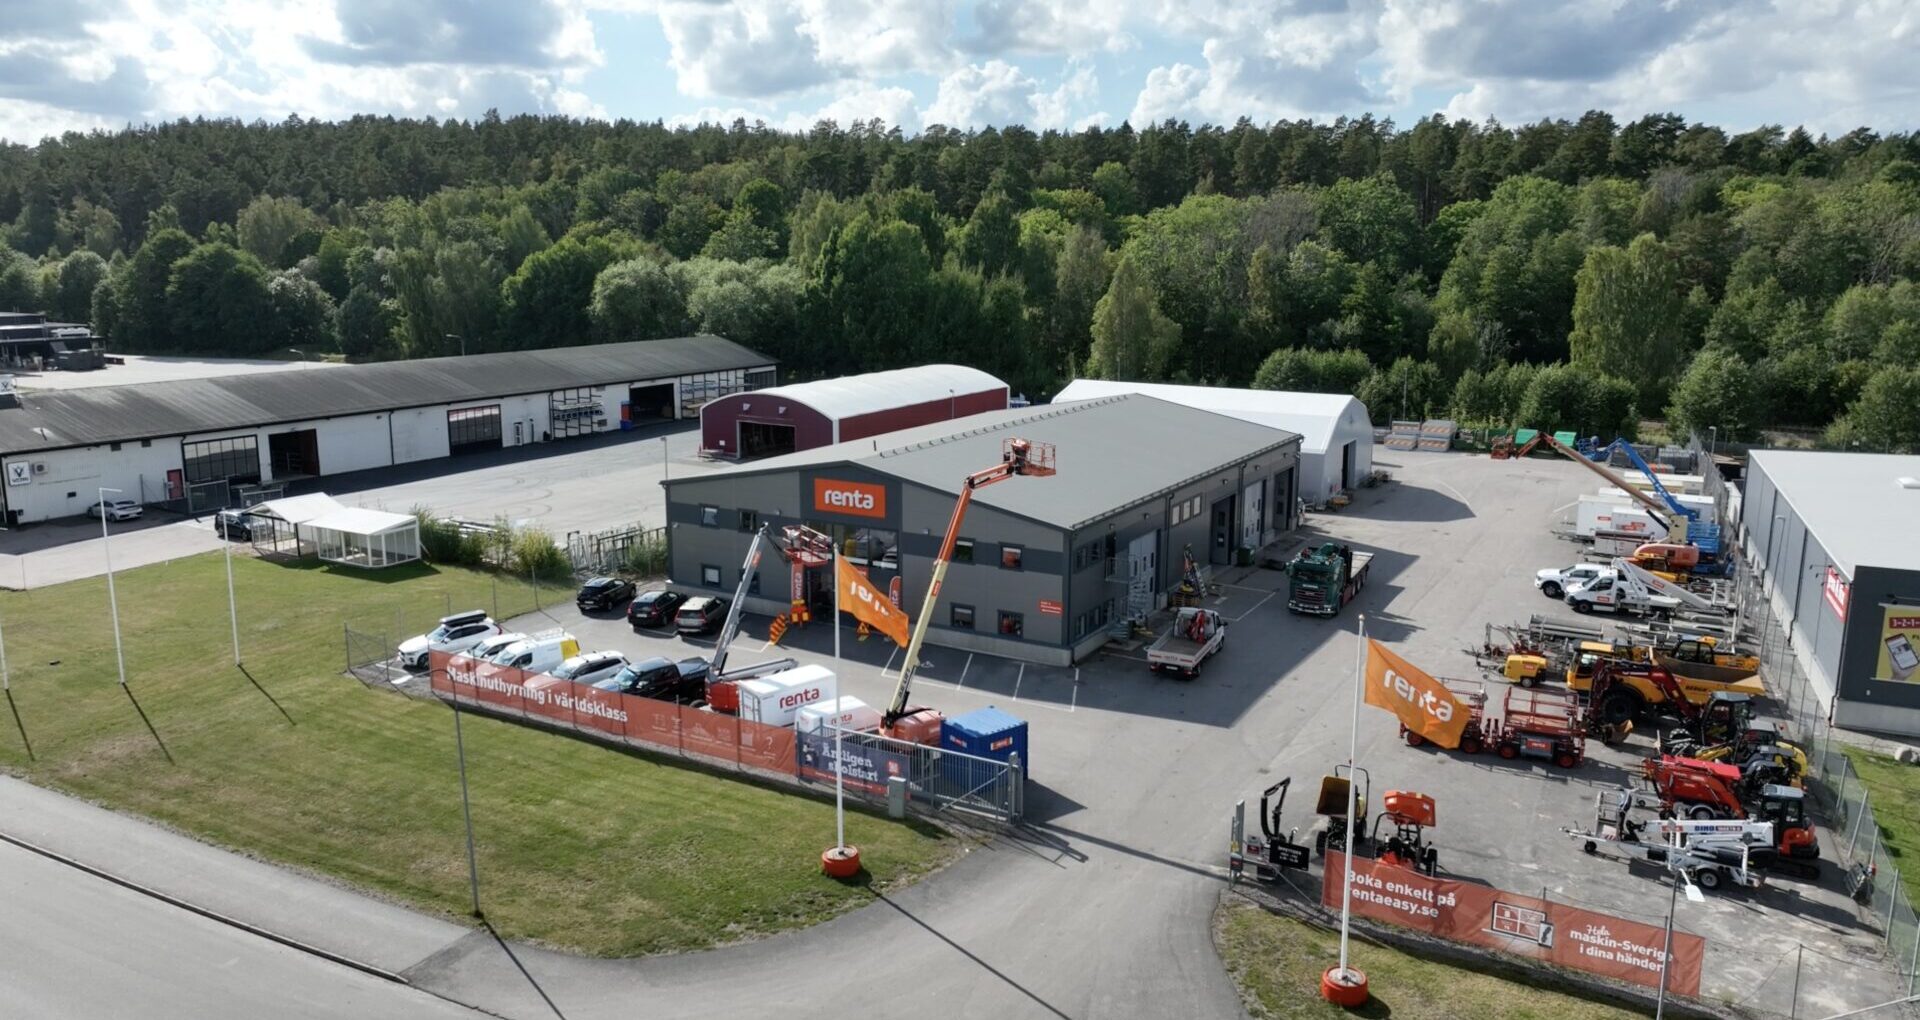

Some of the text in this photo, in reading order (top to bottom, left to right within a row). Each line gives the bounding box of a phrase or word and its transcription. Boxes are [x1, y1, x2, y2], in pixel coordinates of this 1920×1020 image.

[824, 489, 874, 510] renta
[446, 664, 628, 722] Maskinuthyrning i världsklass
[779, 687, 820, 709] renta
[1383, 669, 1453, 722] renta
[1350, 887, 1439, 918] entaeasy.se
[1386, 882, 1434, 902] enkelt
[1437, 892, 1456, 907] på
[1579, 943, 1665, 973] i dina händer
